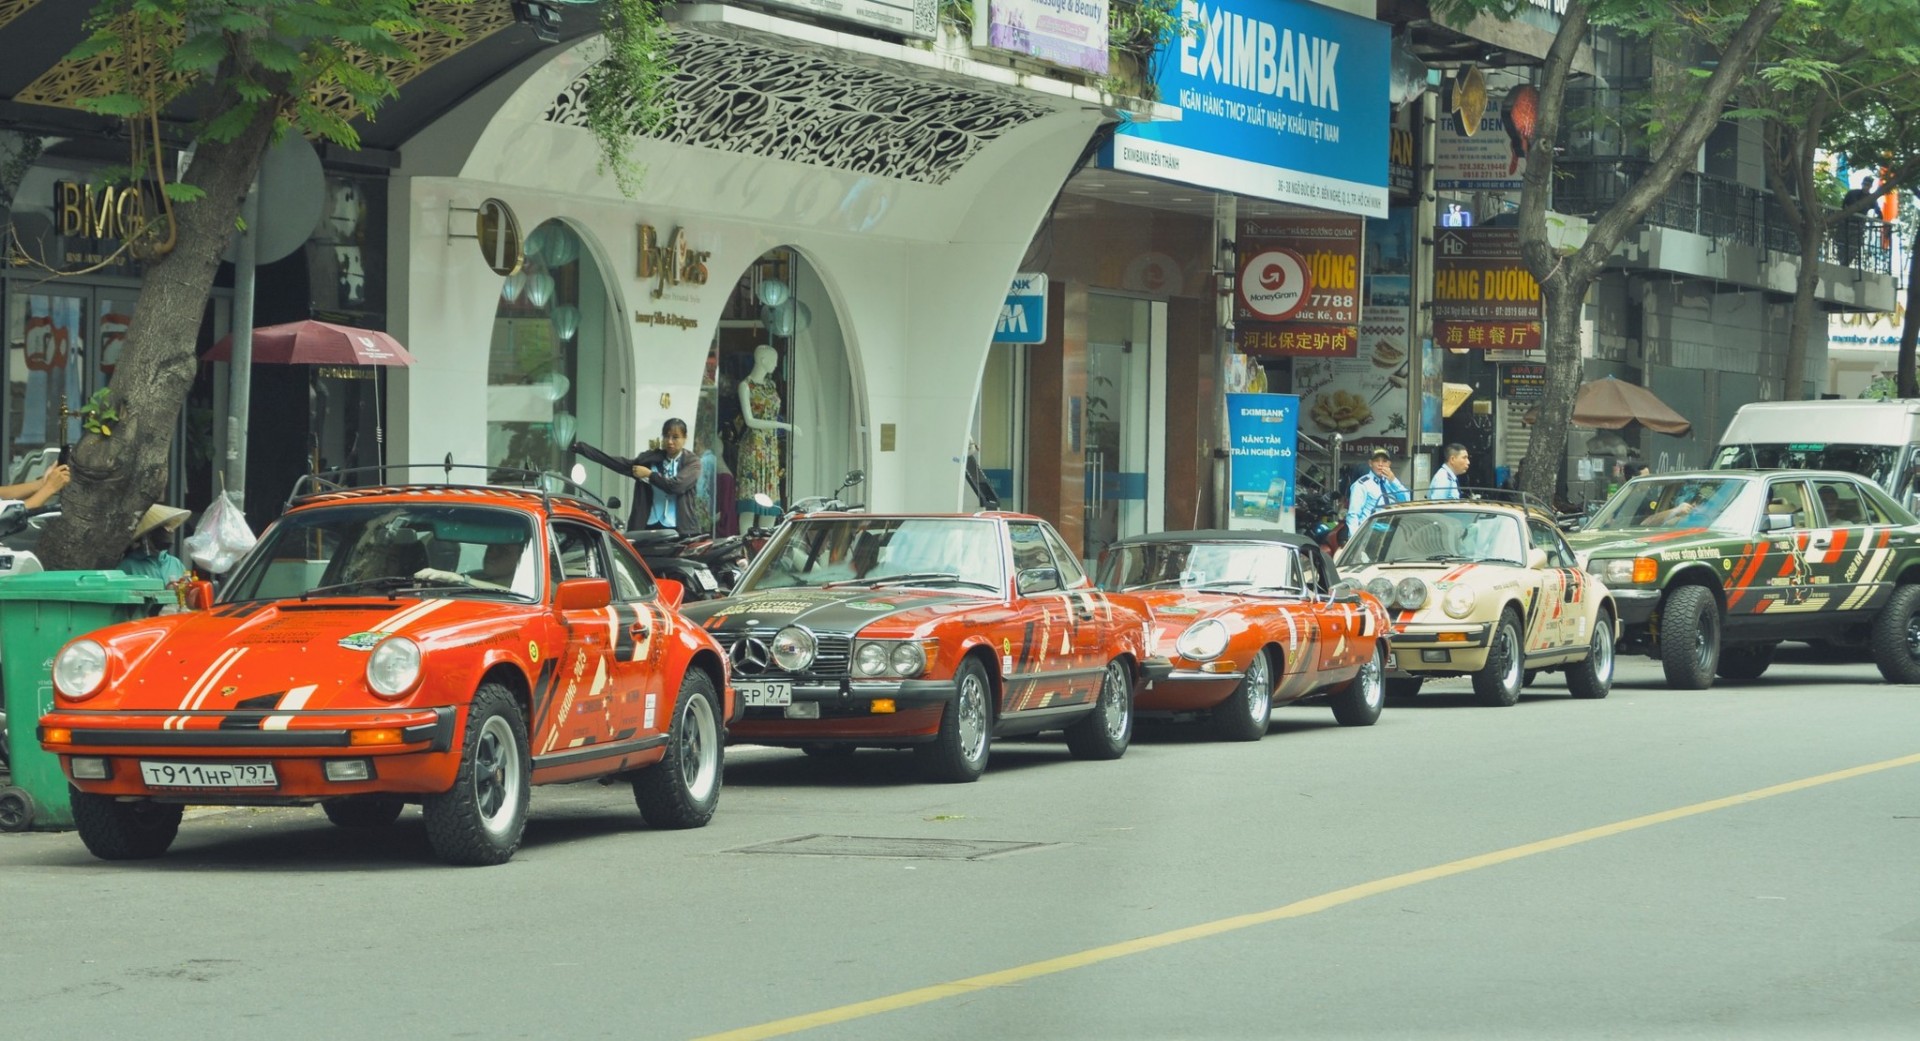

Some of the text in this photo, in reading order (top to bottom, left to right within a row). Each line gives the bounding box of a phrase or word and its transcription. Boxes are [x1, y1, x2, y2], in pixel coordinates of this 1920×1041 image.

[1074, 0, 1103, 24] Beauty
[1180, 0, 1340, 112] EXIMBANK
[1179, 89, 1202, 111] NGÂN
[1202, 96, 1224, 117] HÀNG
[1225, 101, 1246, 122] TMCP
[1307, 117, 1324, 144] VIỆT
[1324, 125, 1340, 144] NAM
[1123, 147, 1150, 165] EXIMBANK
[1307, 249, 1355, 290] ƯƠNG
[1436, 263, 1539, 302] HÀNG DƯƠNG
[1250, 290, 1299, 303] MoneyGram
[1244, 331, 1347, 351] 河北保定驴肉
[1446, 325, 1527, 345] 海鲜餐厅
[1241, 408, 1284, 417] EXIMBANK
[767, 684, 784, 698] 97
[234, 766, 266, 779] 797
